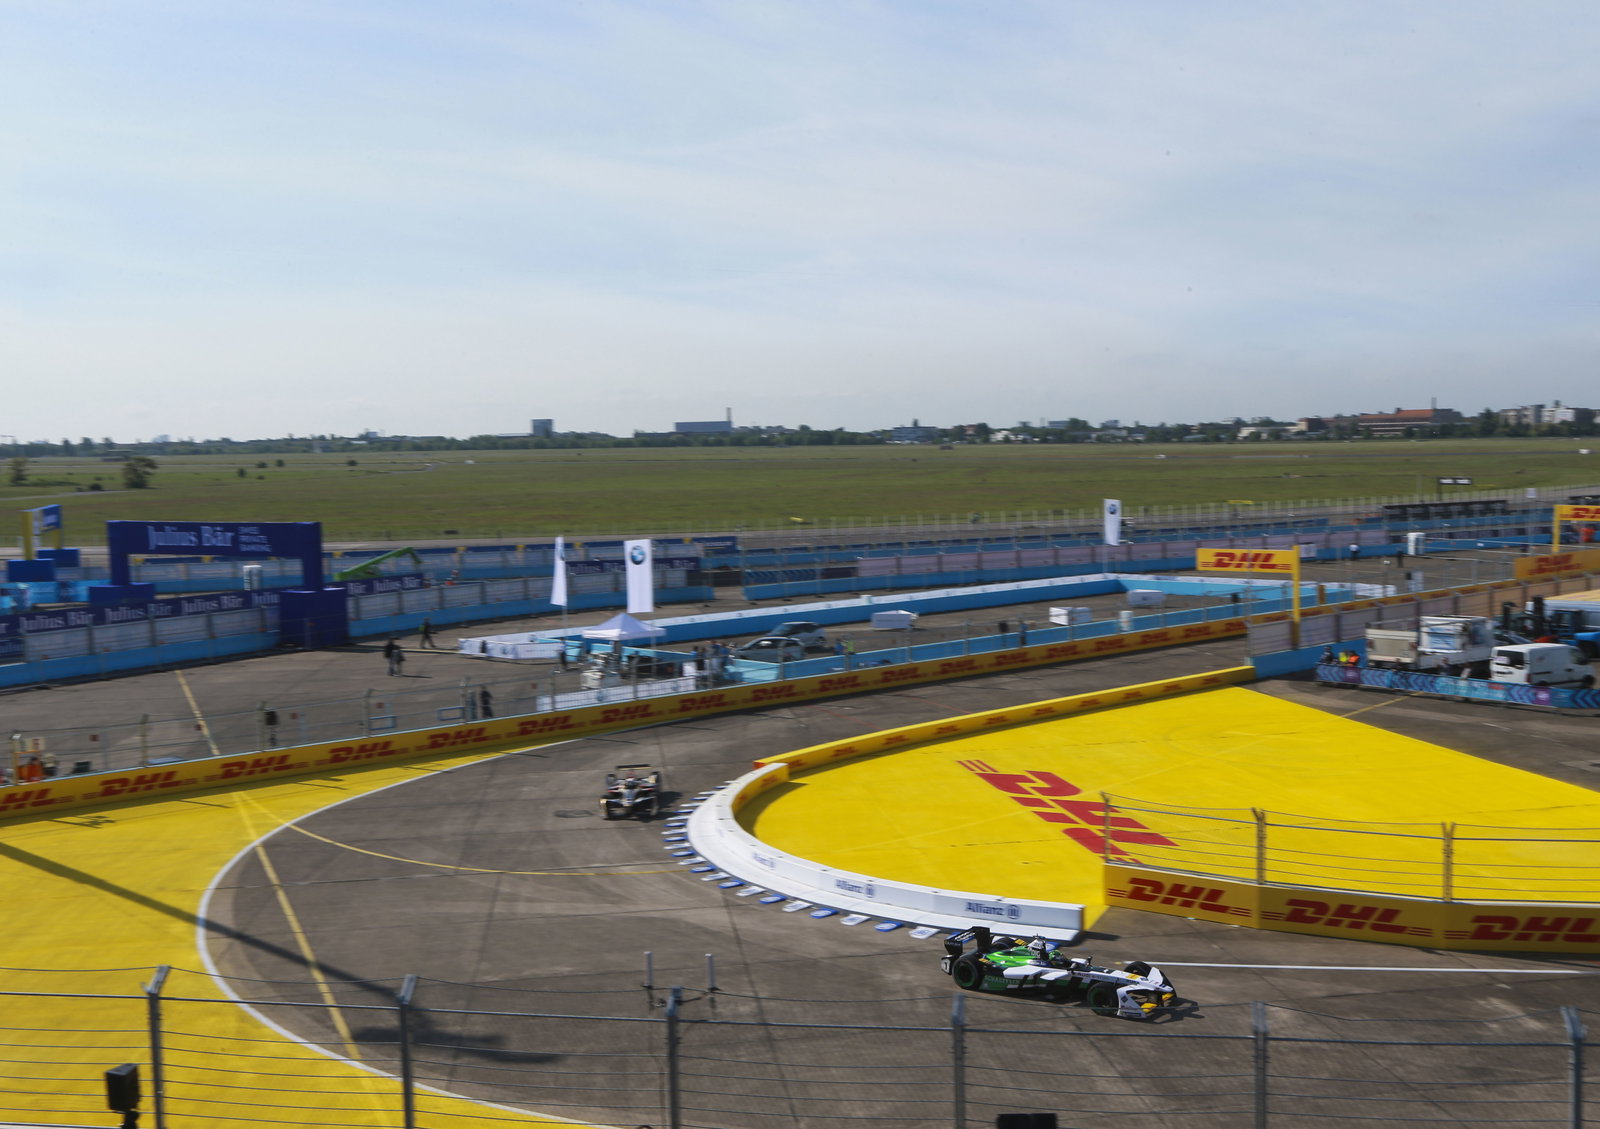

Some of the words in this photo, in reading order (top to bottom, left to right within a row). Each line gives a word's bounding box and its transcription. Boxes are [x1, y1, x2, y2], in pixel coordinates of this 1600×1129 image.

[146, 525, 199, 550] Julius
[200, 526, 235, 546] Bär
[1212, 552, 1278, 570] DHL
[252, 591, 279, 608] Juliu
[601, 704, 657, 723] DHL
[677, 694, 730, 712] DHL
[517, 715, 576, 735] DHL
[427, 727, 490, 749] DHL
[328, 741, 396, 764] DHL
[219, 755, 296, 779] DHL
[98, 771, 182, 797] DHL
[0, 788, 54, 811] HL
[973, 770, 1181, 857] DHL
[1127, 877, 1232, 914] DHL
[965, 902, 1005, 915] Allianz
[1284, 899, 1409, 934] DHL
[1469, 915, 1600, 943] DHL
